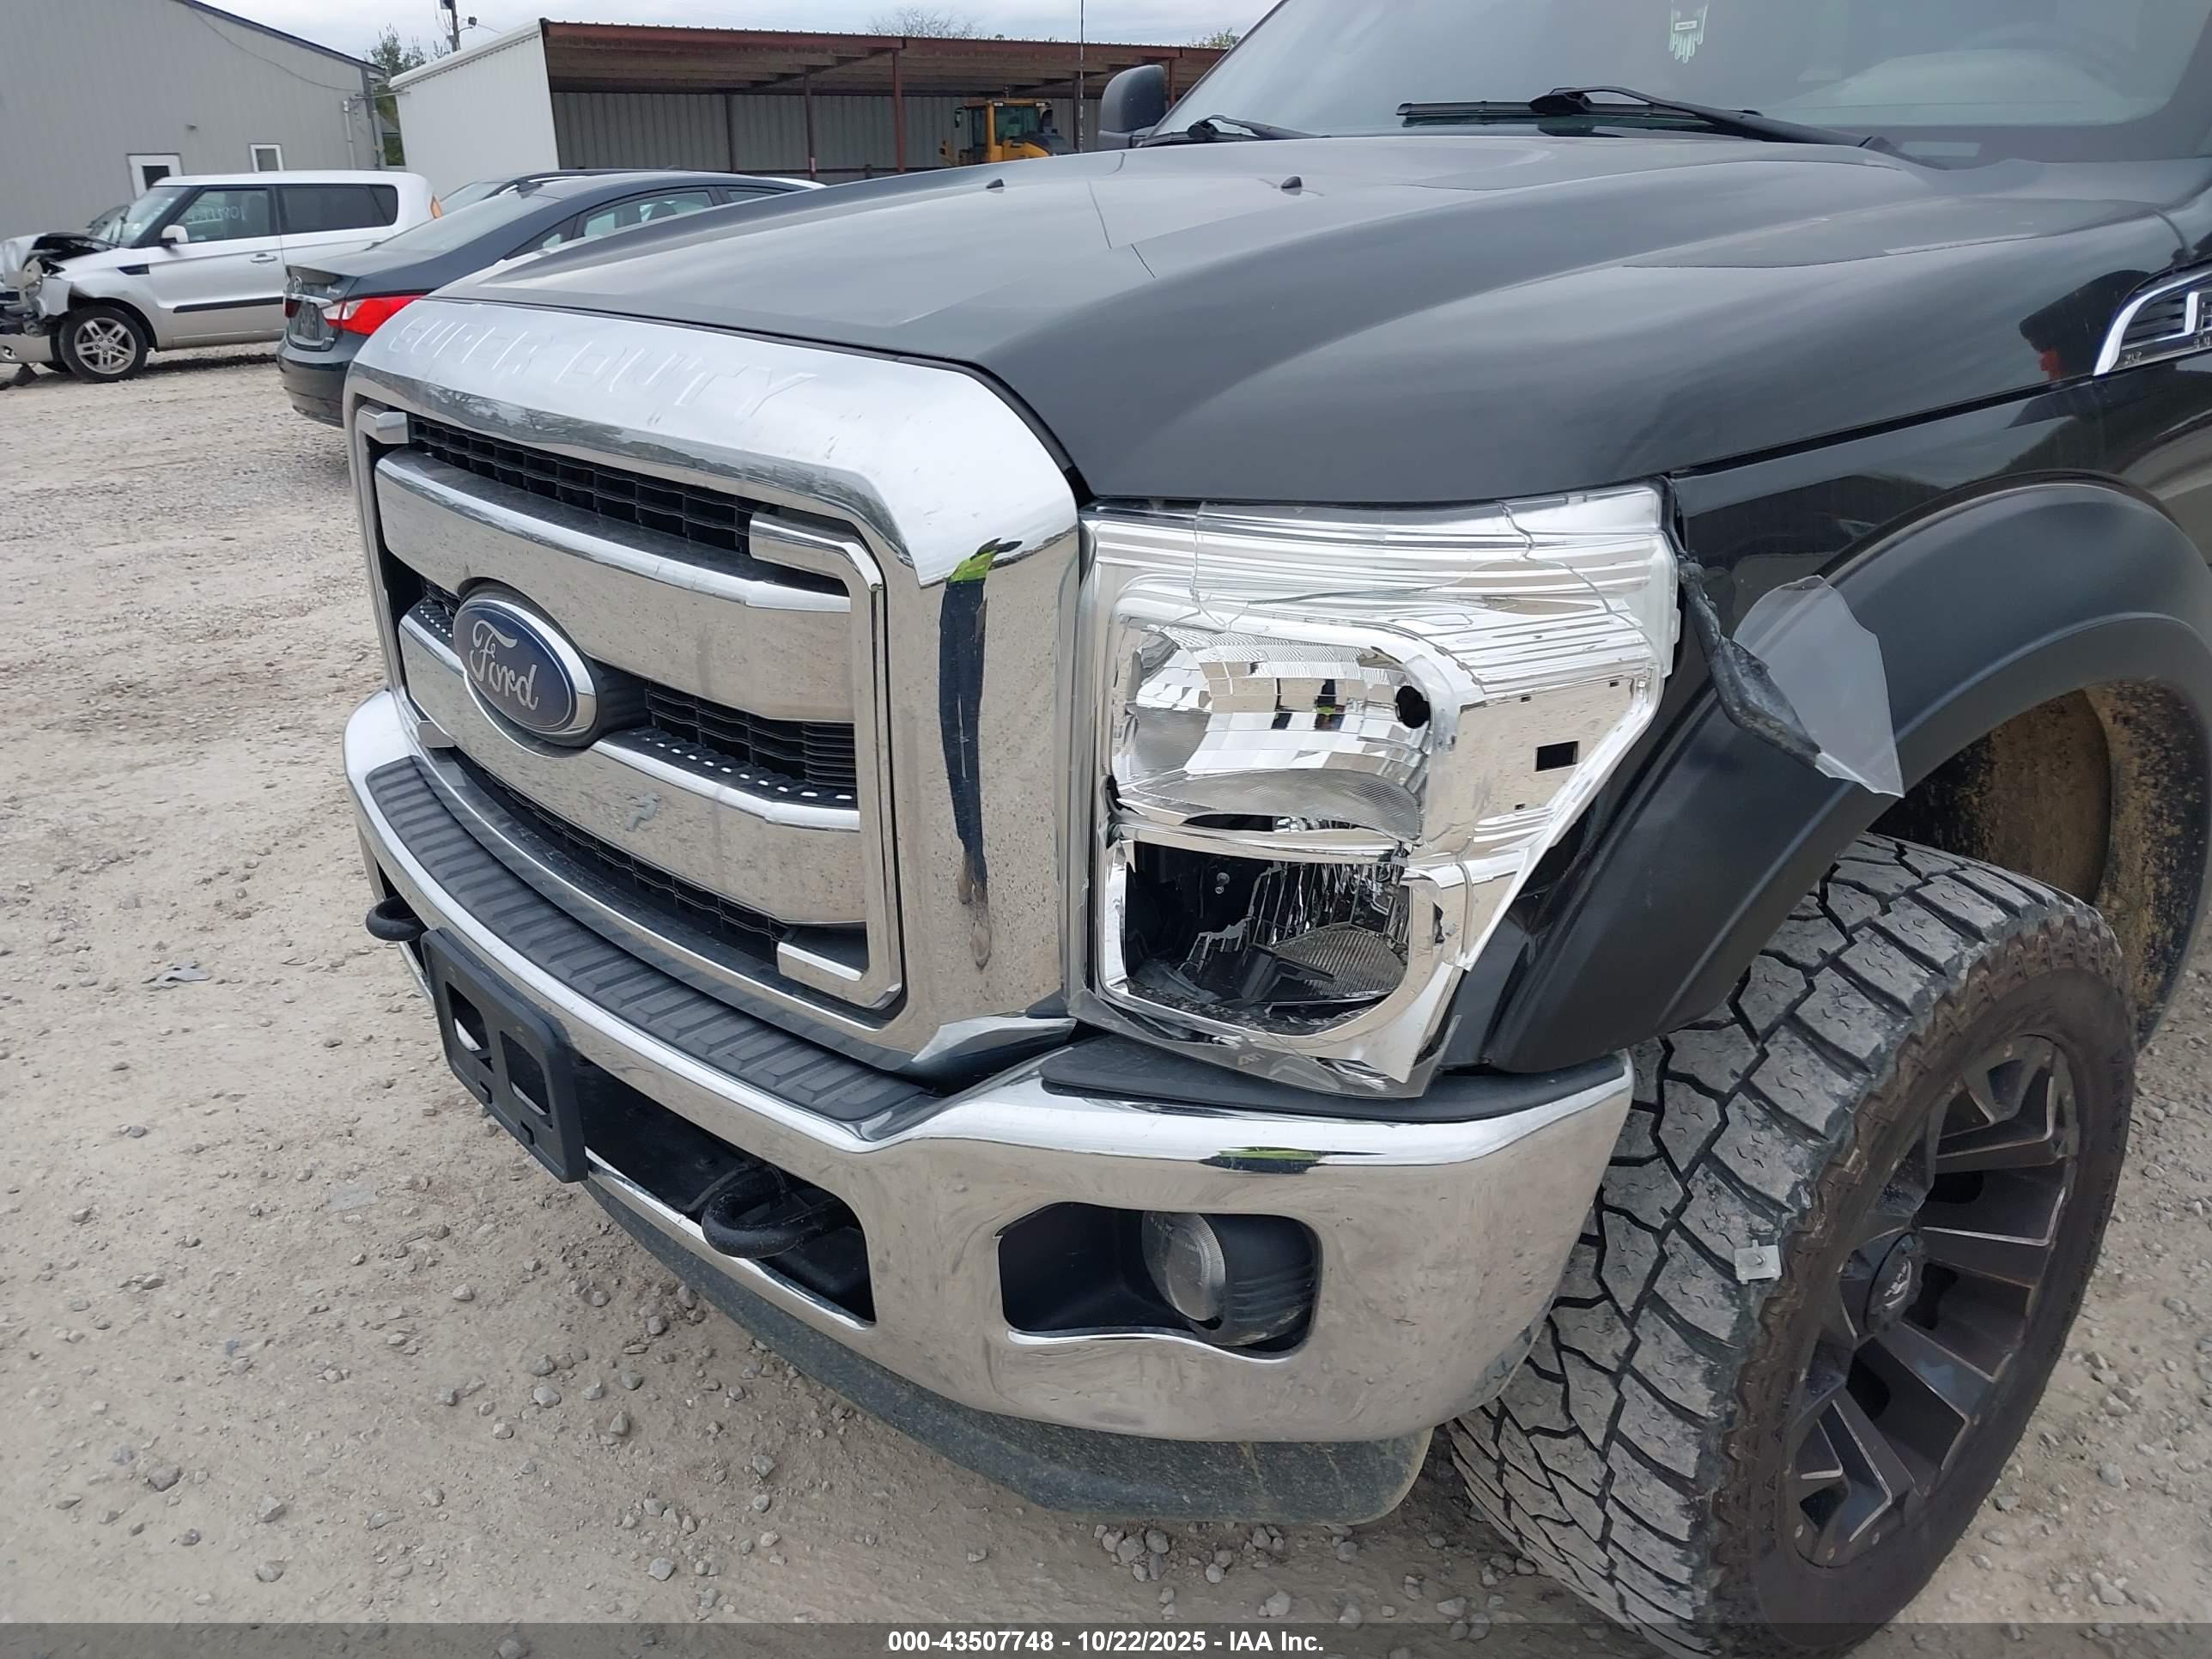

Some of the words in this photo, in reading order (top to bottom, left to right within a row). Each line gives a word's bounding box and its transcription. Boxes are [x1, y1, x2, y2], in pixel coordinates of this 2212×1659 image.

[388, 315, 554, 375] SUPER
[555, 340, 820, 418] DUTY
[470, 619, 539, 711] Ford
